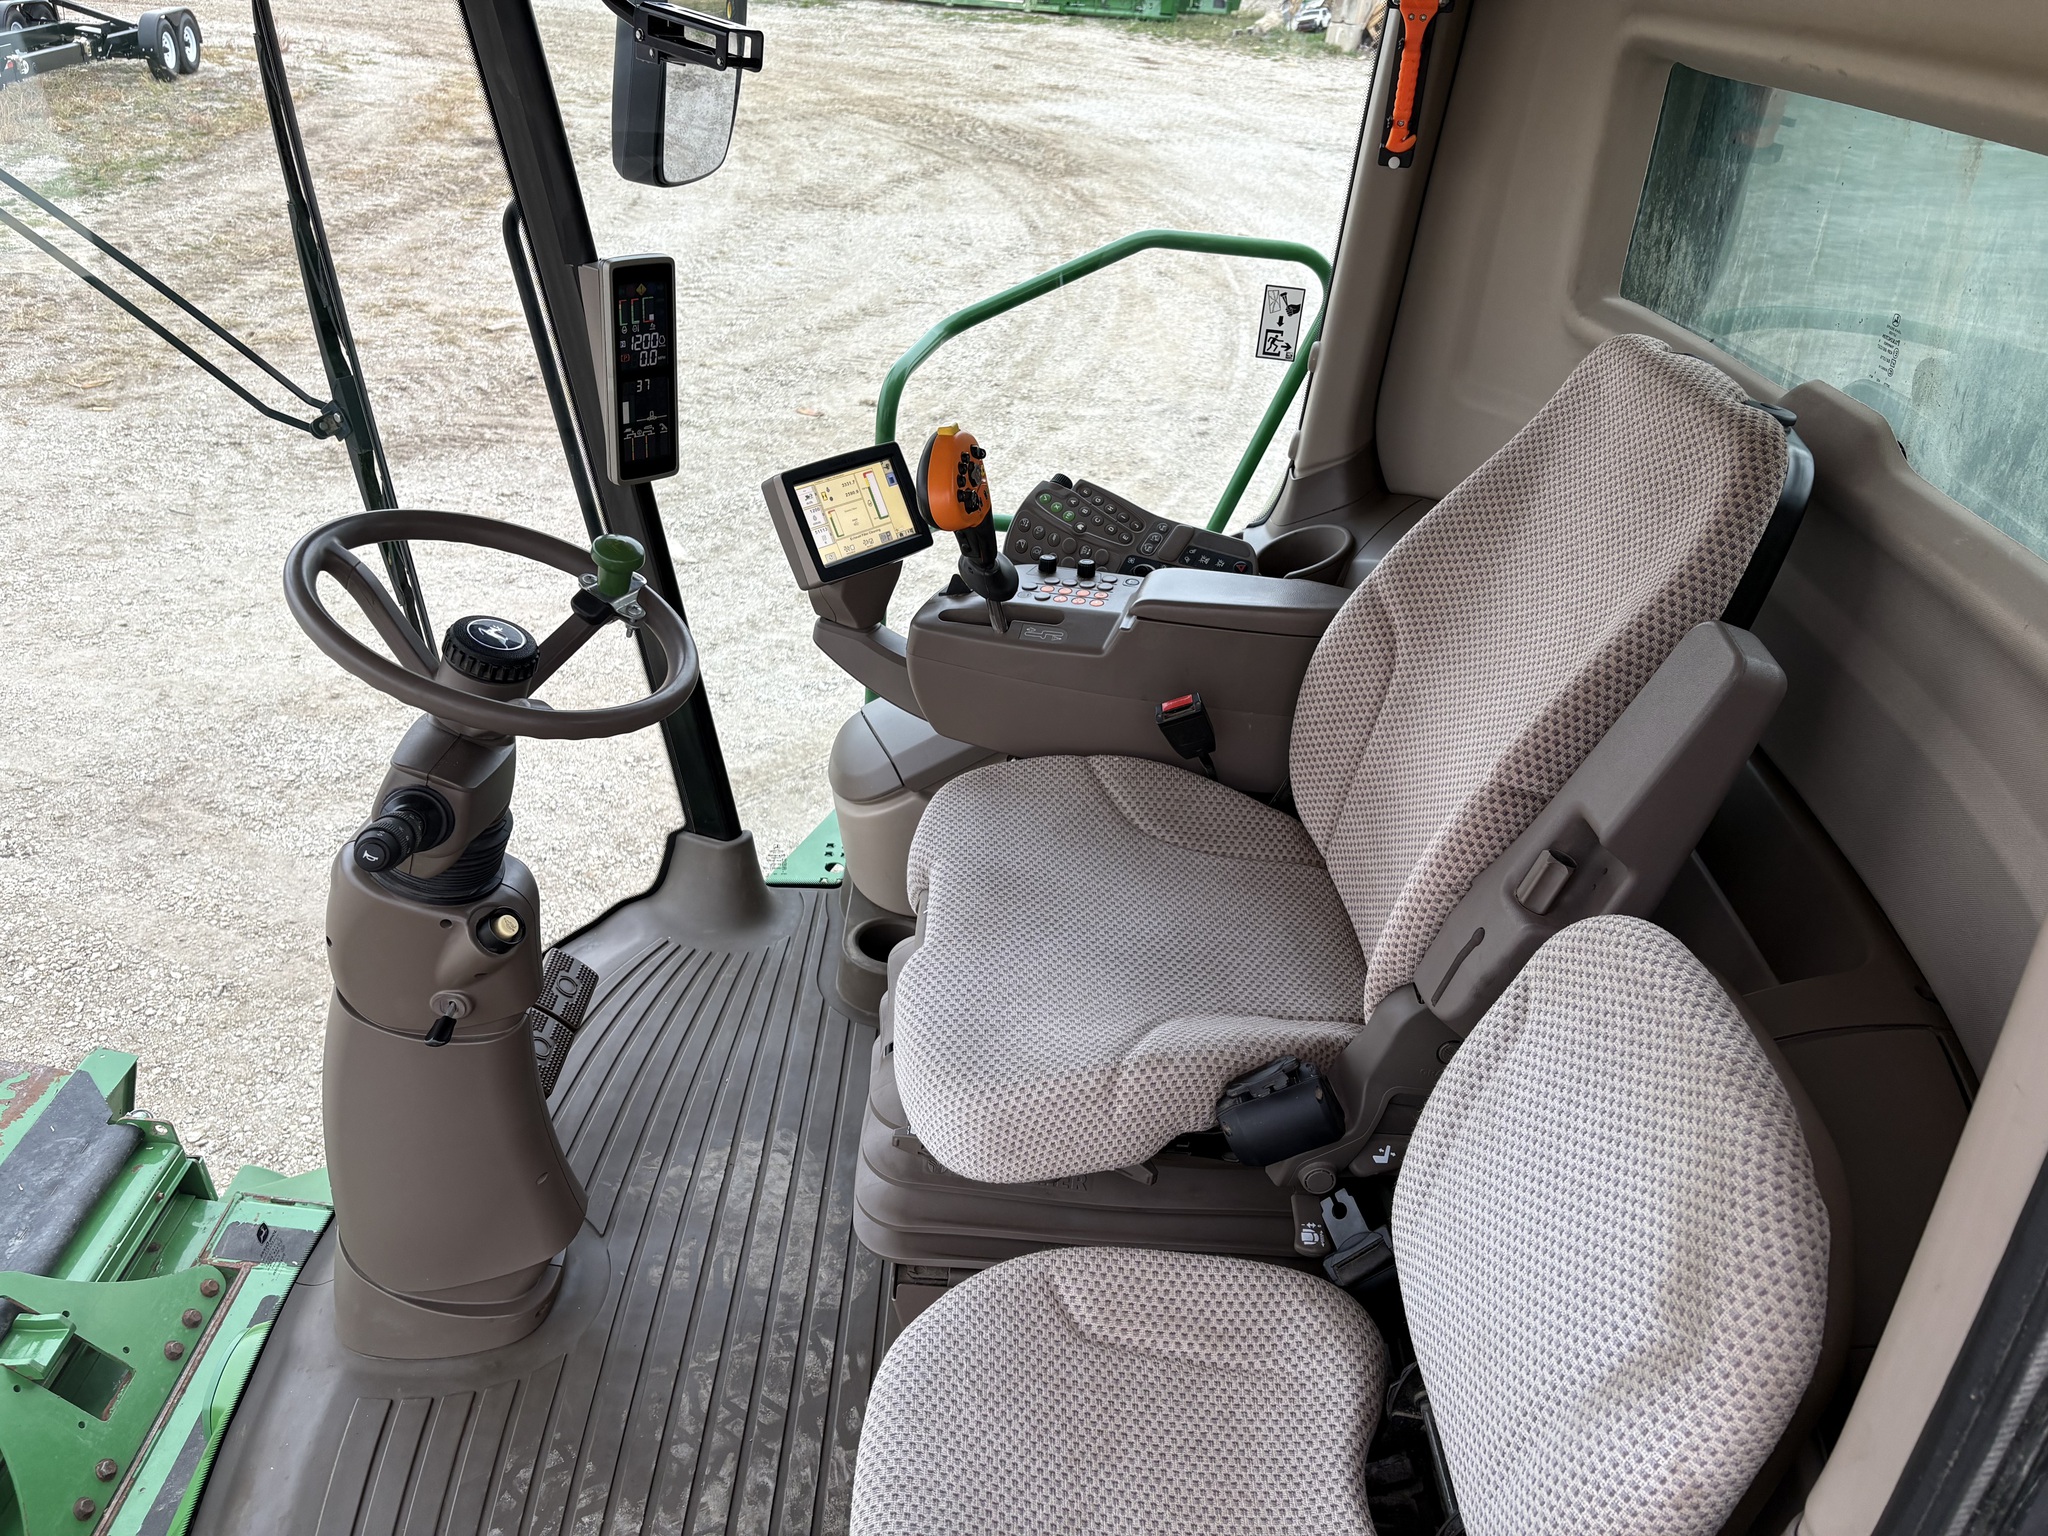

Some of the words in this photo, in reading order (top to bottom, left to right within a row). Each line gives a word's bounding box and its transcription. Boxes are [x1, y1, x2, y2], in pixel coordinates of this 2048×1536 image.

[631, 332, 659, 351] 1200
[639, 349, 658, 367] 0.0
[636, 378, 651, 393] 37
